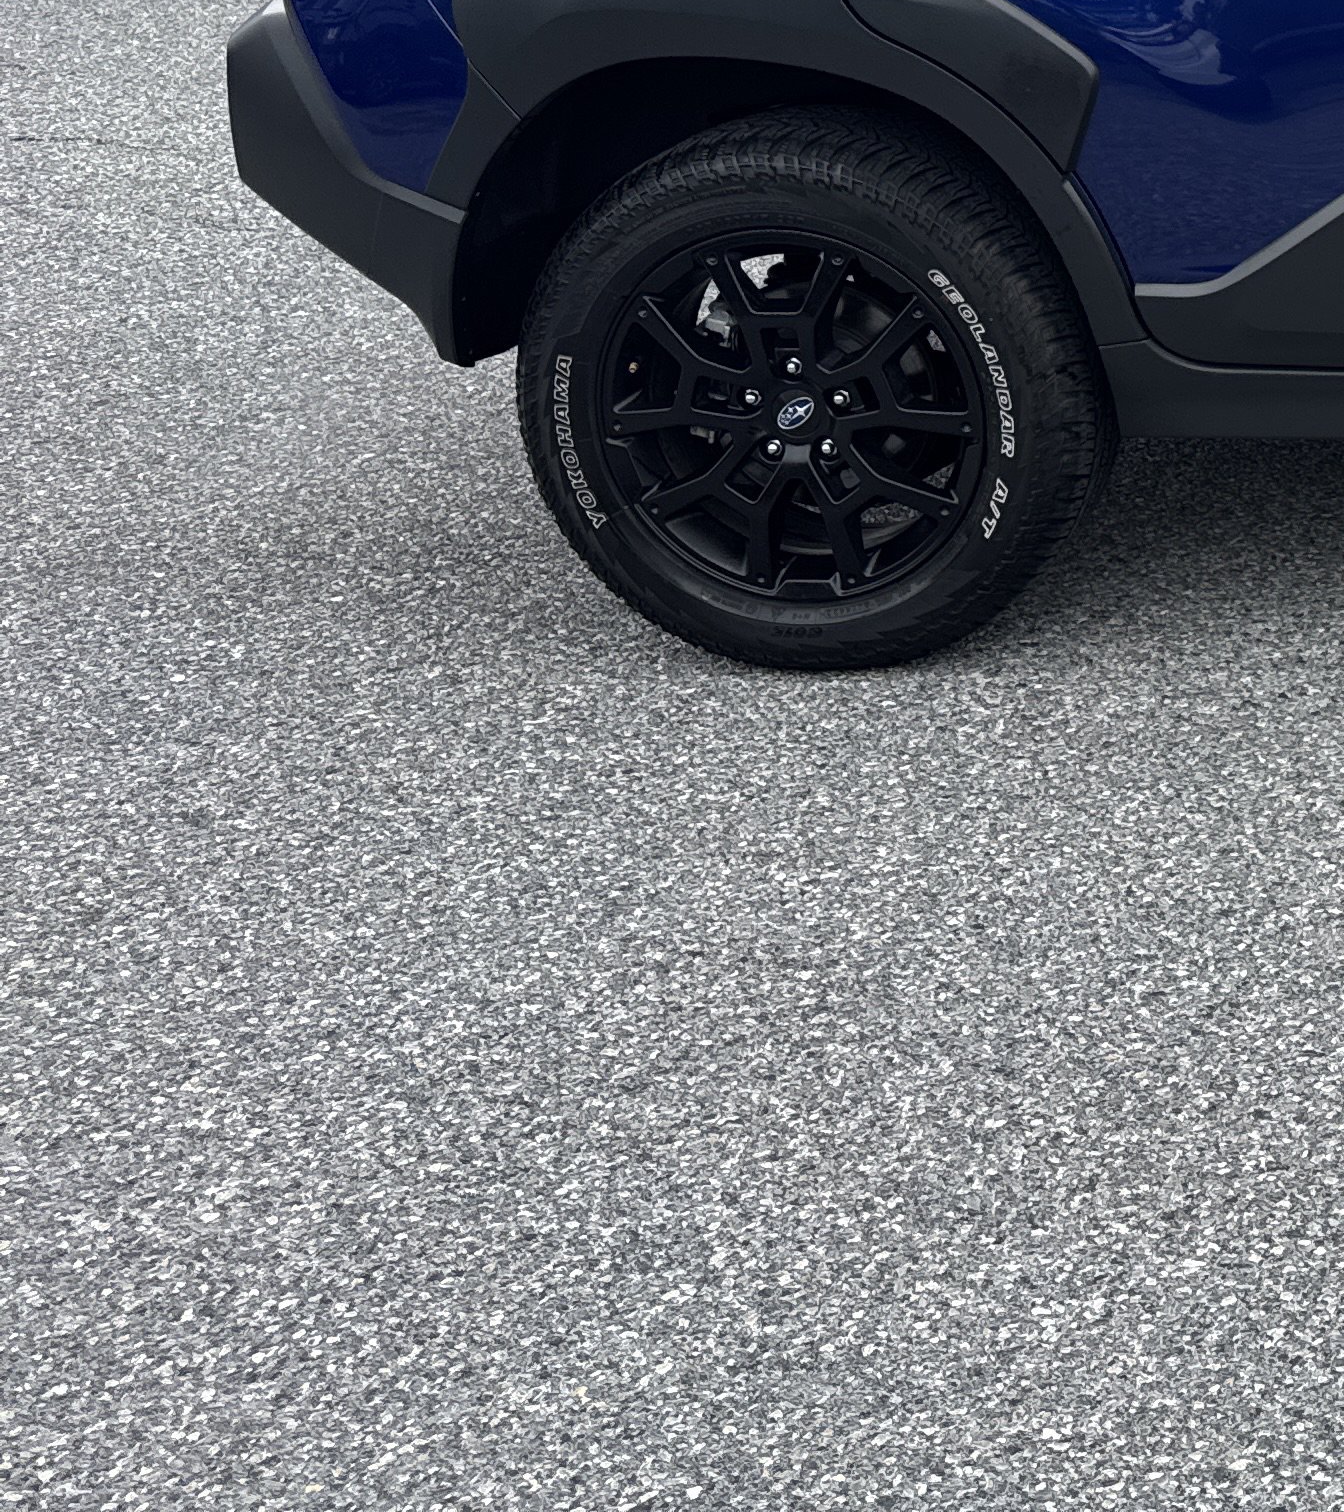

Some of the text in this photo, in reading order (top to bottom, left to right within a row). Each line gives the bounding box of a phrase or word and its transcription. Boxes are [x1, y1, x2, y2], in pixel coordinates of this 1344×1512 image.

[553, 354, 608, 530] YOKOHAMA
[927, 269, 1015, 540] GEOLANDAR A/T
